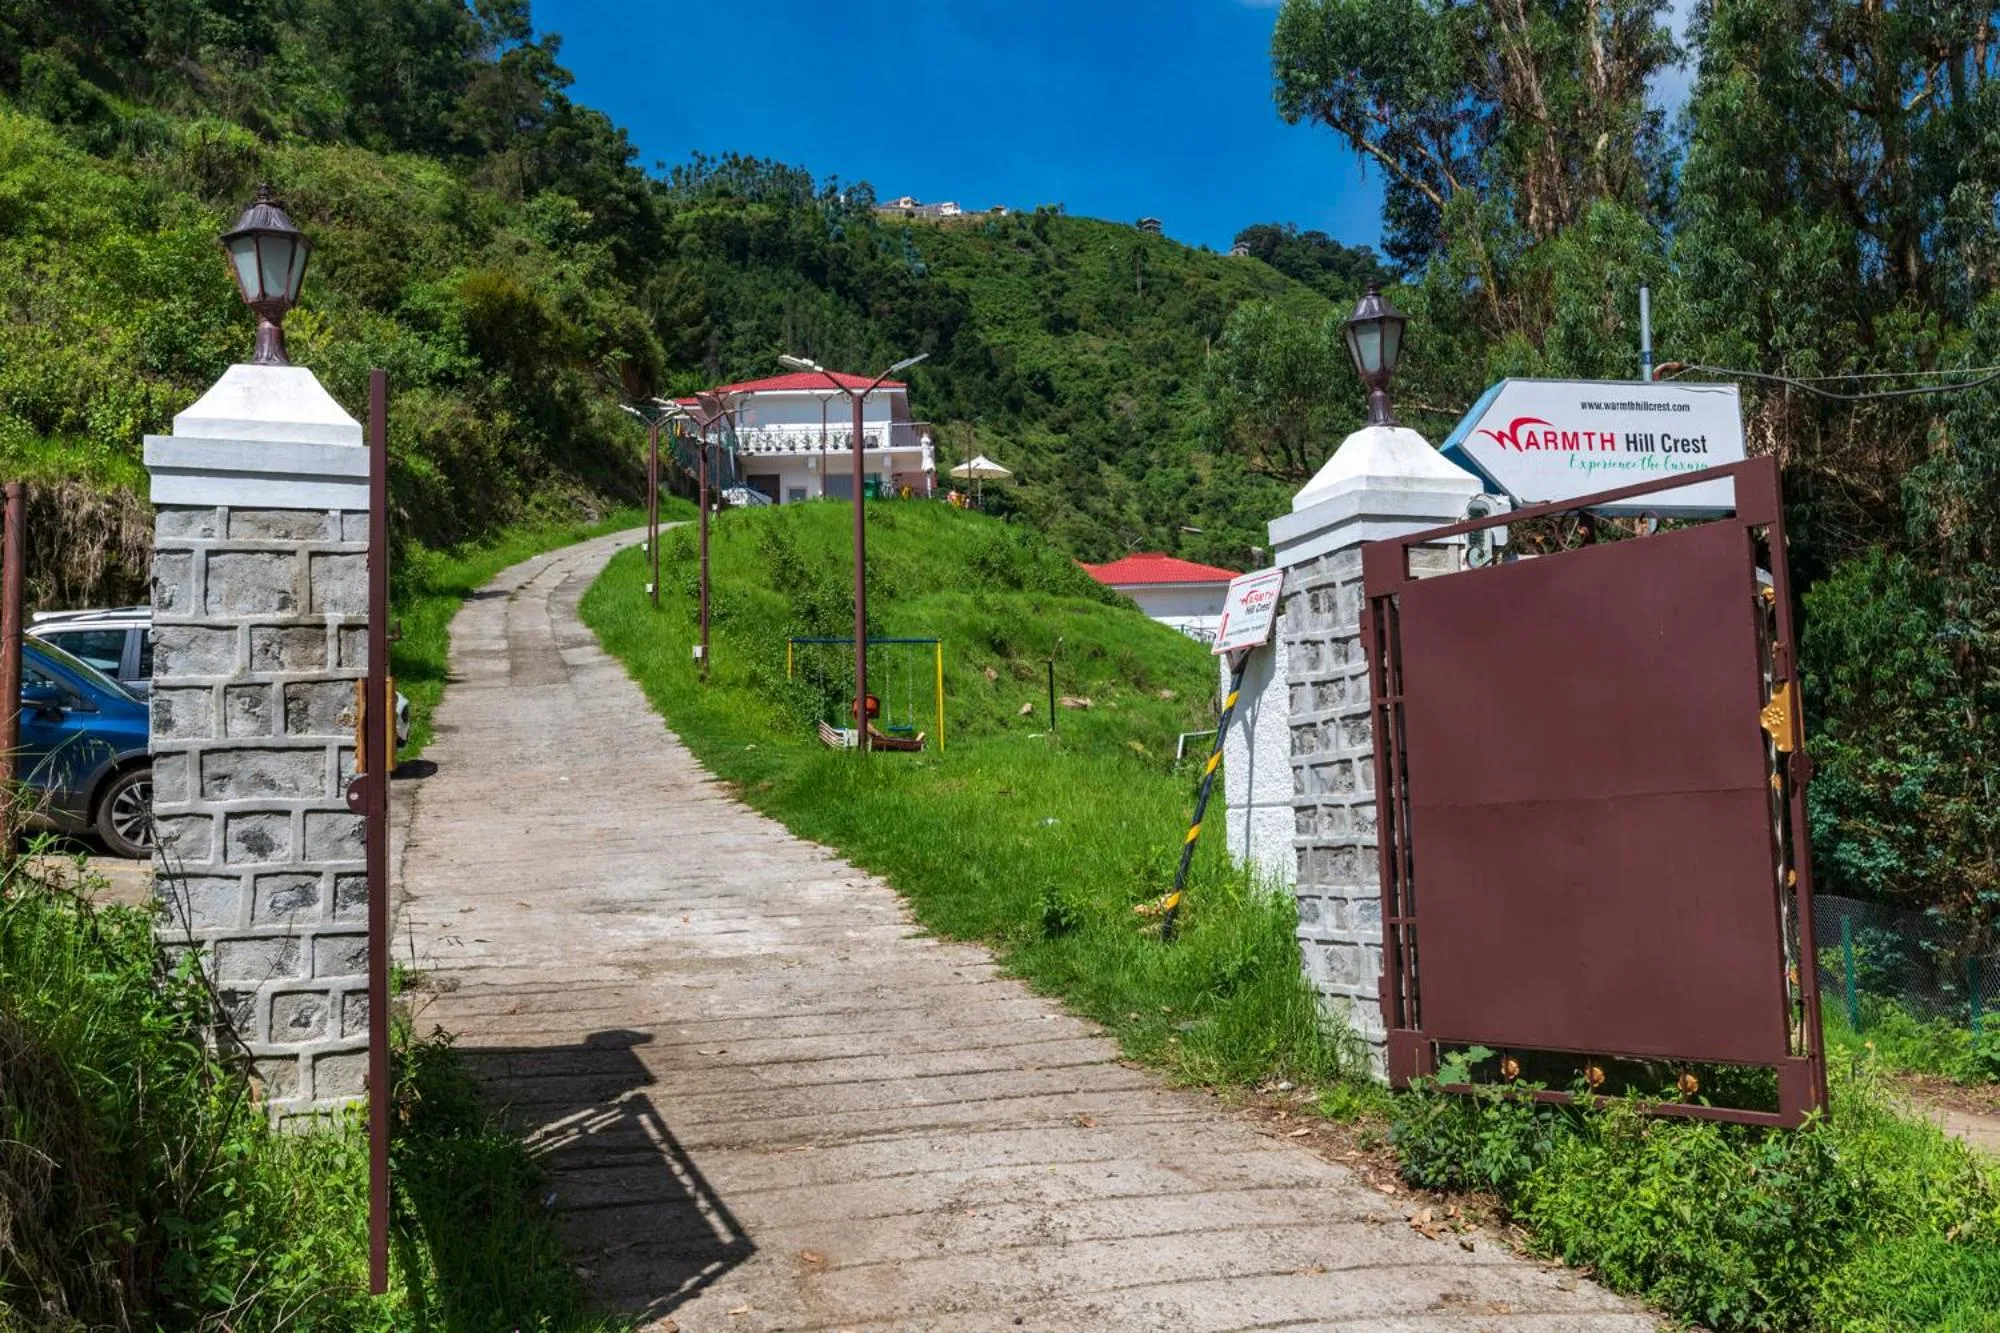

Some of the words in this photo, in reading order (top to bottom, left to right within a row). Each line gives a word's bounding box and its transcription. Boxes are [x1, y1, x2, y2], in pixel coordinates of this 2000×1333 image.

[1580, 401, 1690, 412] www.warmthhillcrest.com
[1477, 417, 1615, 452] WARMTH
[1626, 433, 1654, 453] Hill
[1661, 434, 1708, 454] Crest
[1569, 454, 1636, 477] Experience
[1641, 454, 1659, 471] the
